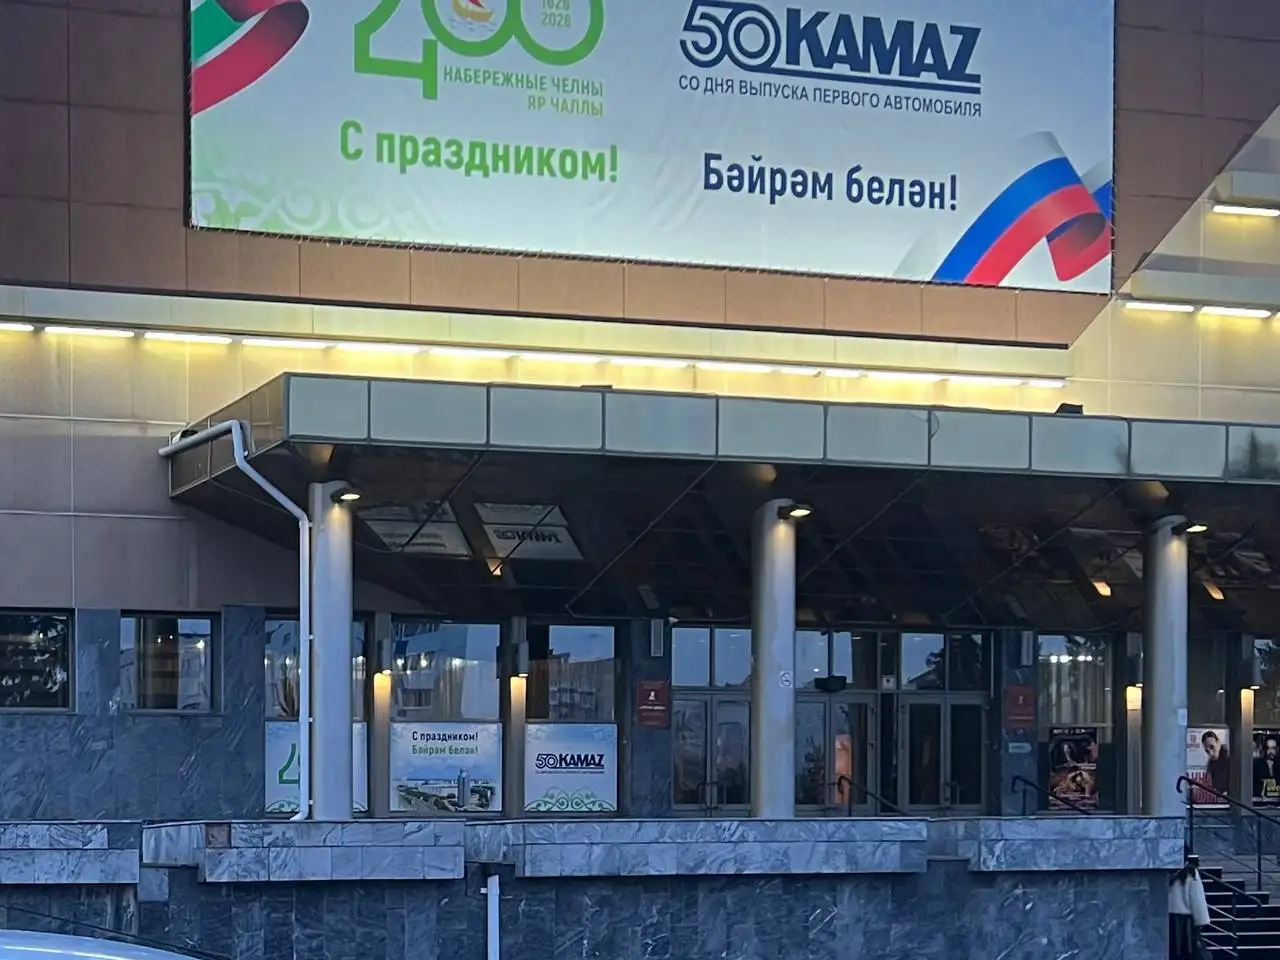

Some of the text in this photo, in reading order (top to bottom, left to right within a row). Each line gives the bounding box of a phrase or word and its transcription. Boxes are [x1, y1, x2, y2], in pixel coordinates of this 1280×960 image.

[443, 65, 603, 97] НАБЕРЕЖНЫЕ ЧЕЛНЫ
[678, 75, 982, 118] СО ДНЯ ВЫПУСКА ПЕРВОГО АВТОМОБИЛЯ
[527, 95, 603, 117] ЯР ЧАЛЛЫ
[339, 119, 618, 182] С праздником!
[703, 152, 958, 212] Бәйрәм белән!
[412, 731, 479, 743] С праздником!
